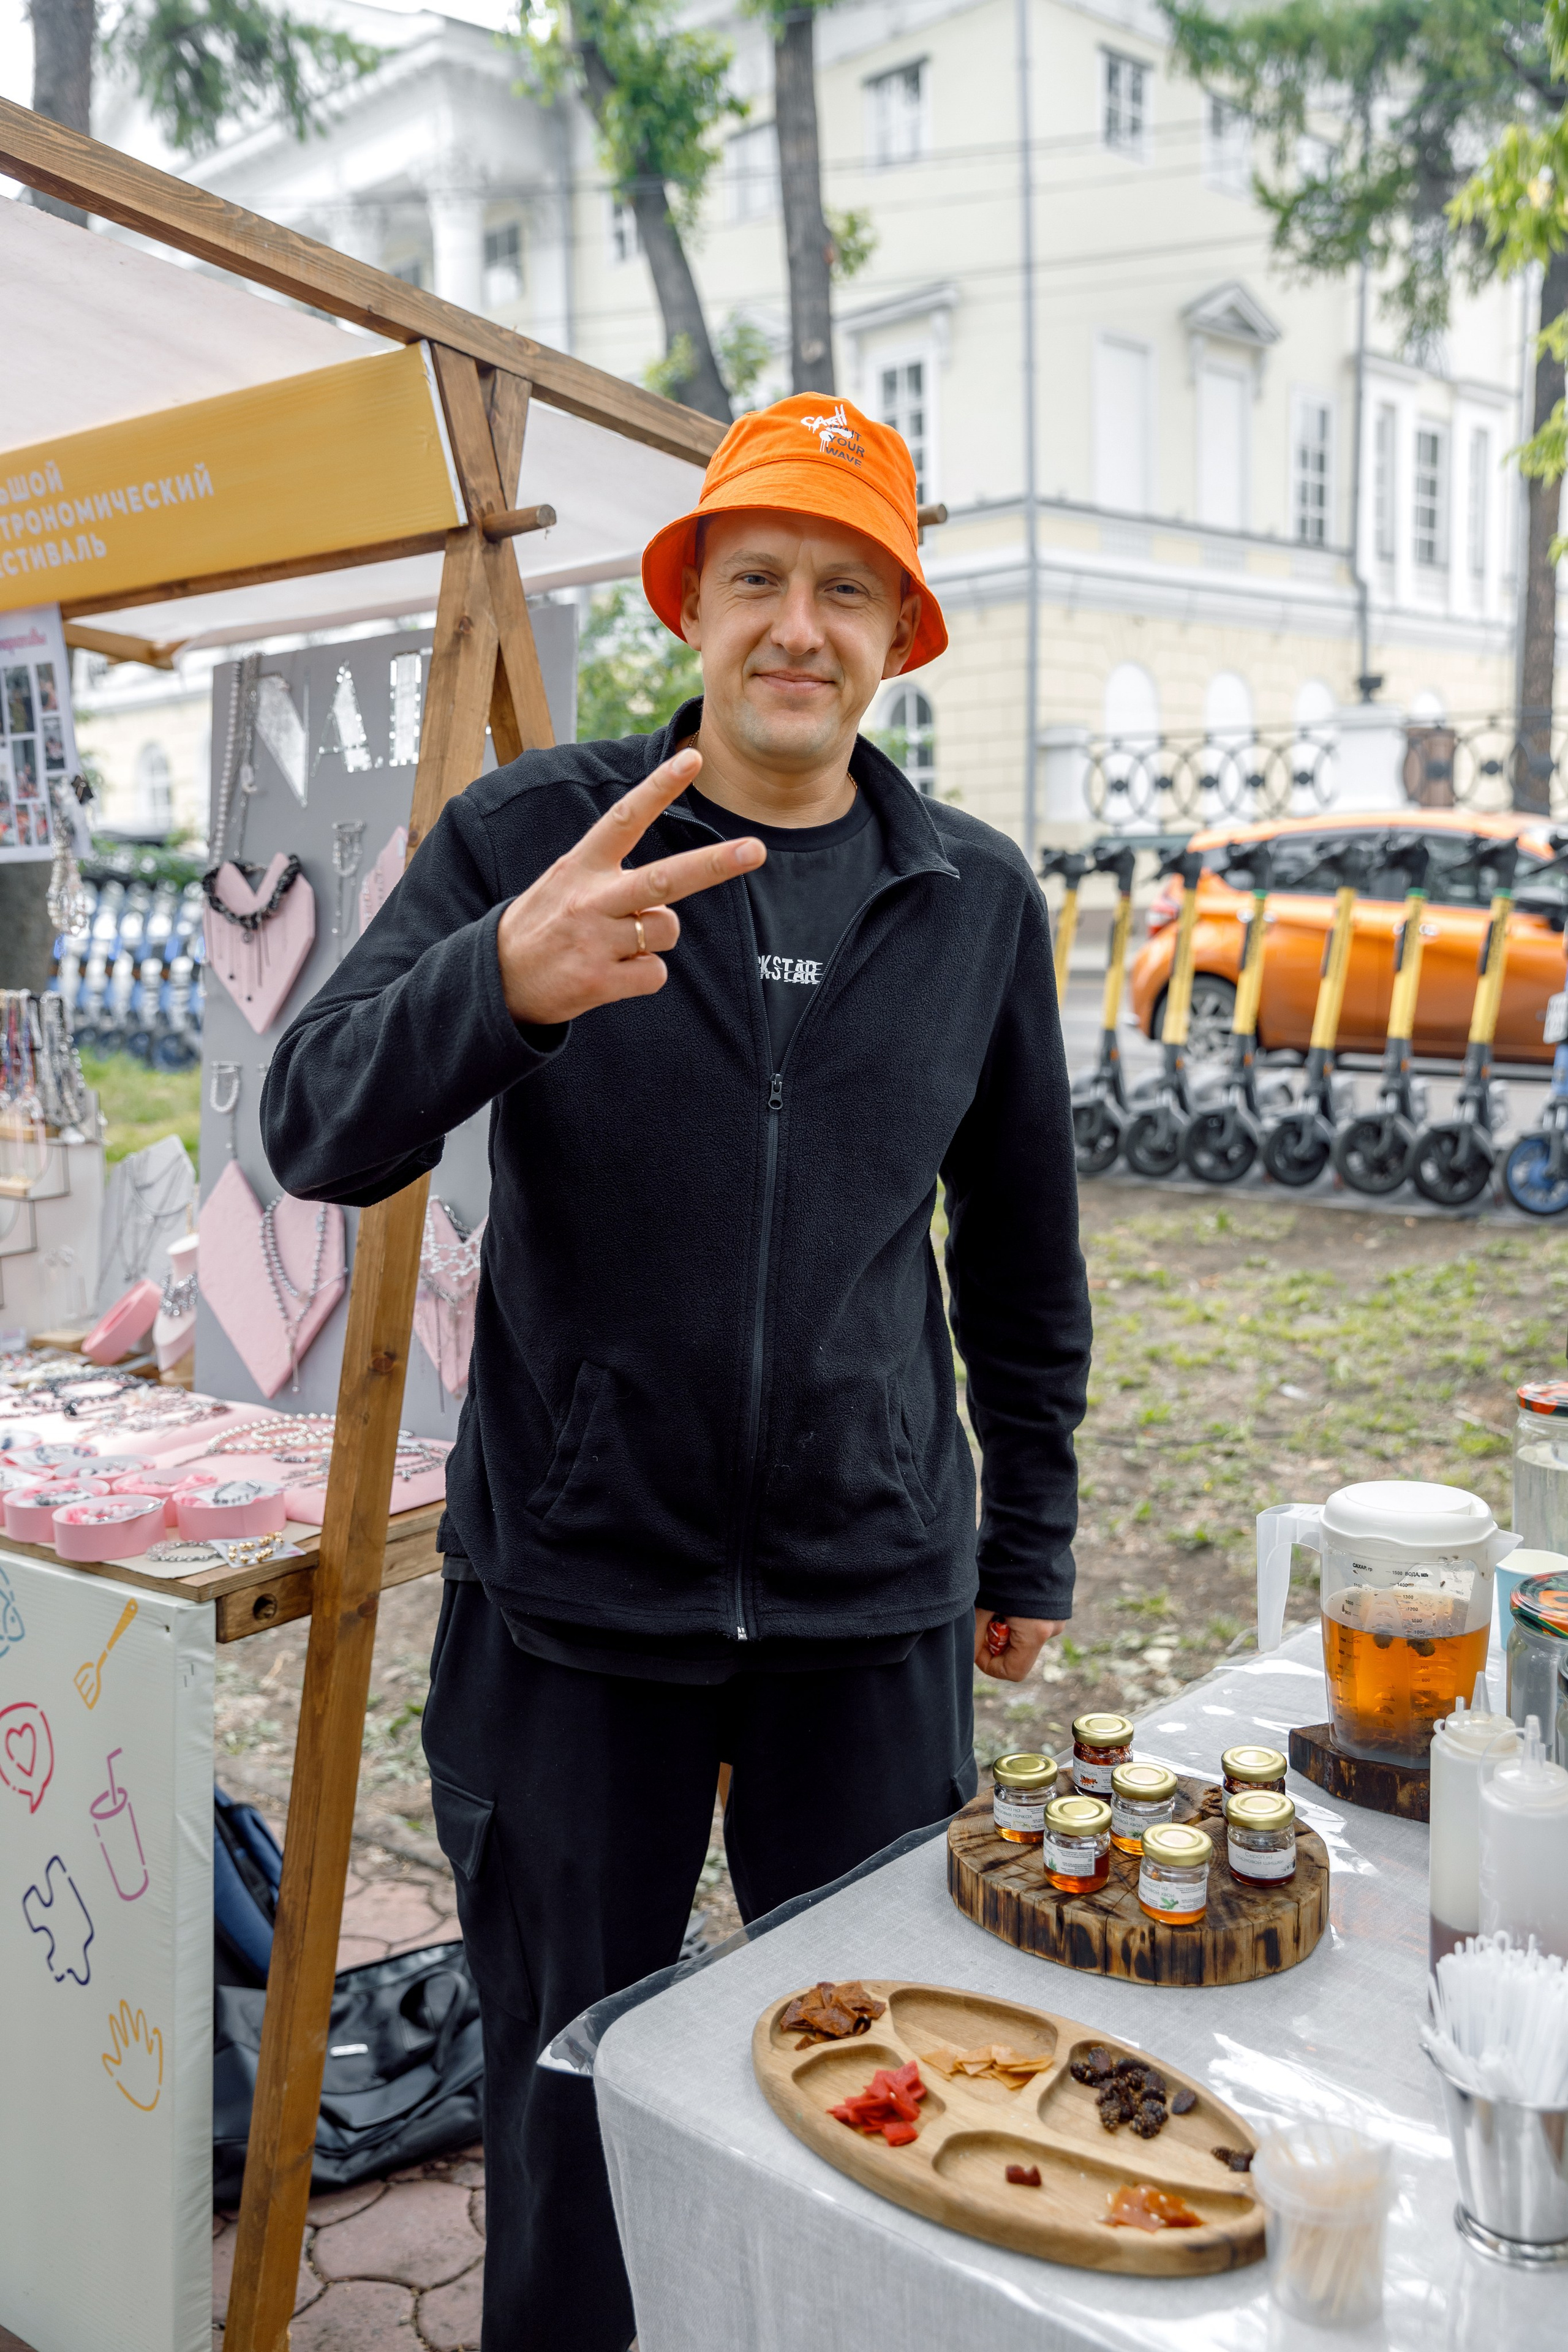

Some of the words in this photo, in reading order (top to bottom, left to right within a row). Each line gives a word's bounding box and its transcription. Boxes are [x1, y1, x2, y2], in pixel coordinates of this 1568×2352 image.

[828, 435, 865, 458] YOUR
[826, 447, 862, 469] WAVE
[0, 533, 107, 578] СТИВАЛЬ
[997, 1802, 1012, 1811] Сироп
[1235, 1853, 1262, 1865] сосновой
